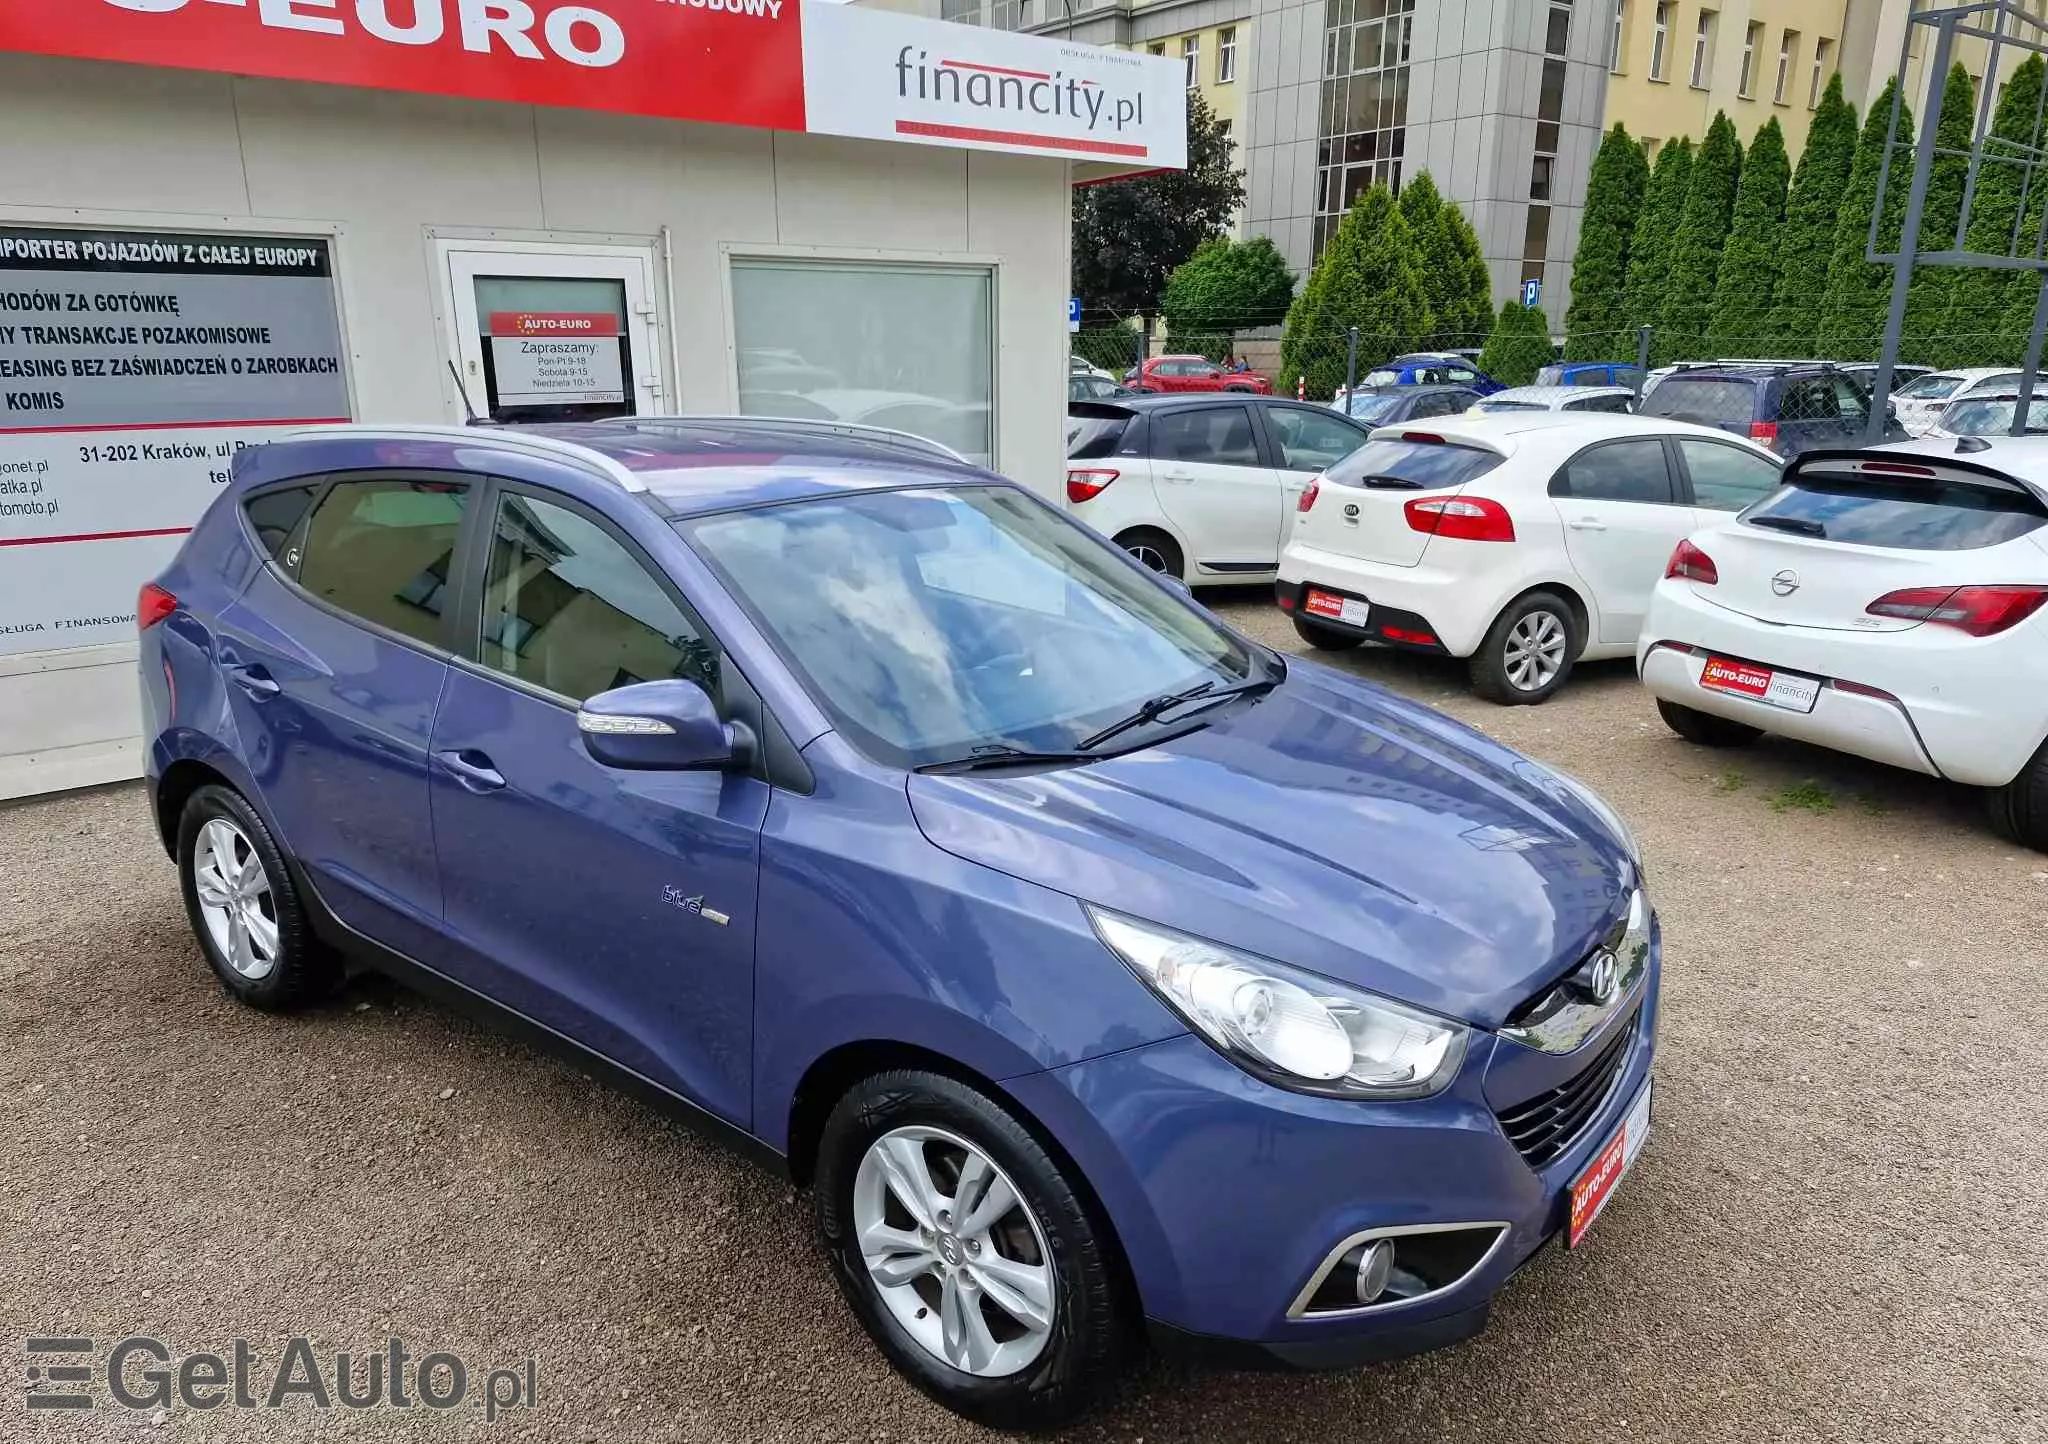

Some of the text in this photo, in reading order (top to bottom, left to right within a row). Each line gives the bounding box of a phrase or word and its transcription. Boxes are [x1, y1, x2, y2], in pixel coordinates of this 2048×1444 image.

[895, 46, 1143, 130] financity.pl
[82, 240, 178, 263] POJAZDÓW
[183, 245, 195, 263] Z
[199, 245, 250, 265] CAŁEJ
[254, 247, 317, 266] EUROPY
[66, 294, 90, 312] ZA
[95, 291, 180, 317] GOTÓWKĘ
[21, 326, 138, 345] TRANSAKCJE
[143, 327, 271, 345] POZAKOMISOWE
[524, 319, 591, 329] AUTO-EURO
[520, 341, 599, 356] Zapraszamy:
[0, 354, 338, 378] EASING BEZ ZAŚWIADCZEŃ O ZAROBKACH
[6, 391, 64, 410] KOMIS
[80, 445, 138, 463] 31-202
[143, 441, 211, 460] Kraków,
[1710, 667, 1767, 688] AUTO-EURO
[663, 885, 701, 913] blue
[1574, 1142, 1622, 1213] AUTO-EURO
